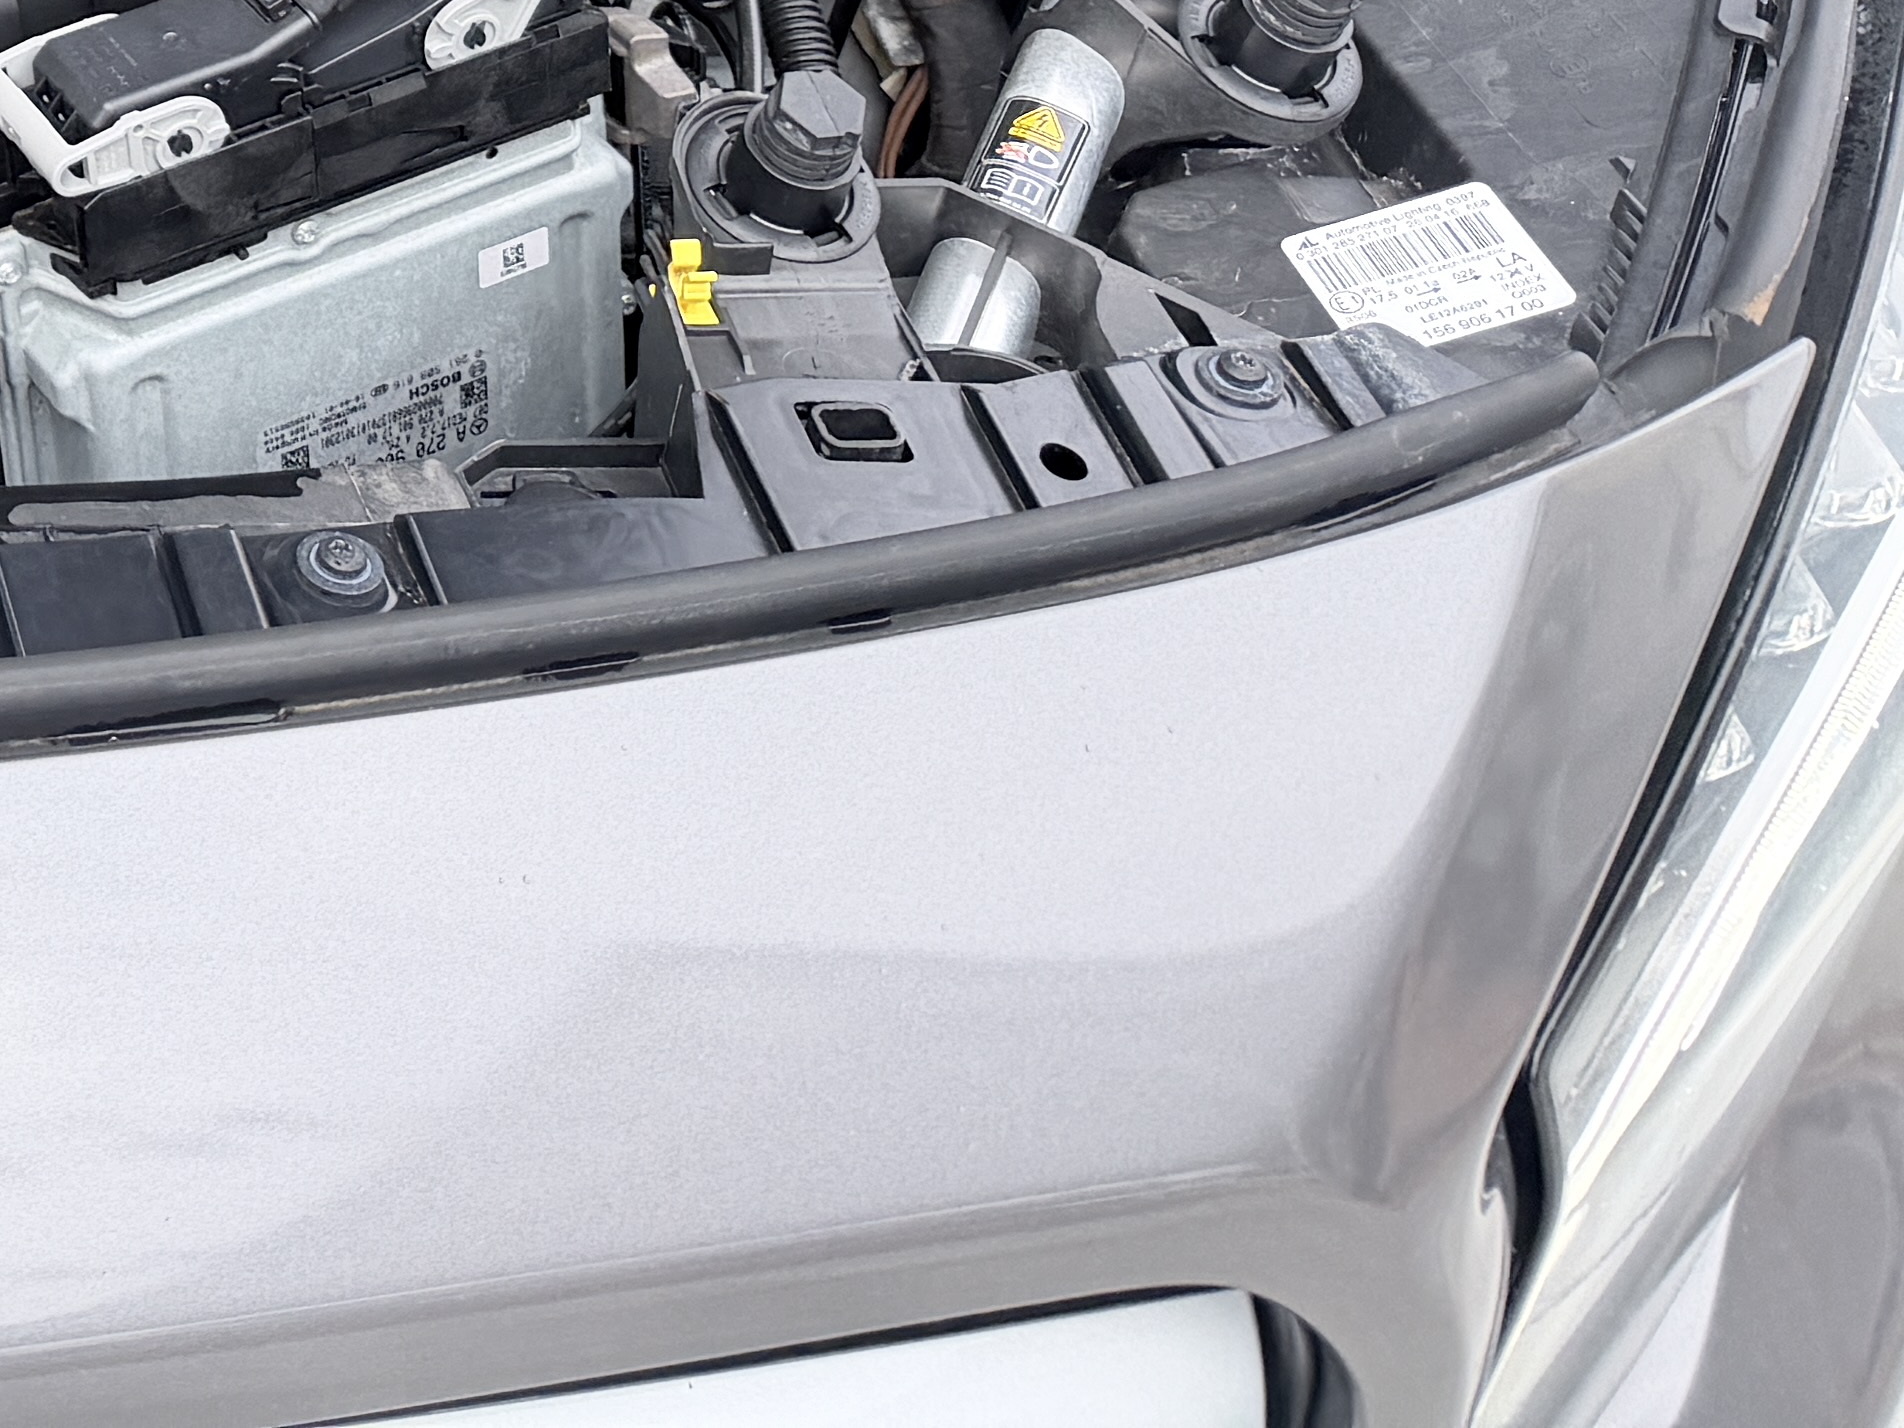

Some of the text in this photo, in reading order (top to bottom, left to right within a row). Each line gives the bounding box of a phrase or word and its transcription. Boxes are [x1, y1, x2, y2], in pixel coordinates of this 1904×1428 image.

[1322, 214, 1392, 241] Automotive
[1391, 200, 1442, 222] Lighting
[1294, 252, 1305, 261] 0
[1330, 237, 1356, 250] 285
[1381, 224, 1400, 235] 07
[1423, 212, 1441, 223] 04
[1494, 250, 1527, 268] LA
[1488, 271, 1506, 283] 12
[1524, 262, 1537, 272] V
[1499, 272, 1545, 291] INDEX
[1360, 283, 1381, 296] PL
[1422, 297, 1545, 340] 156 906 17 00
[407, 369, 461, 401] BOSCH
[455, 423, 467, 444] A
